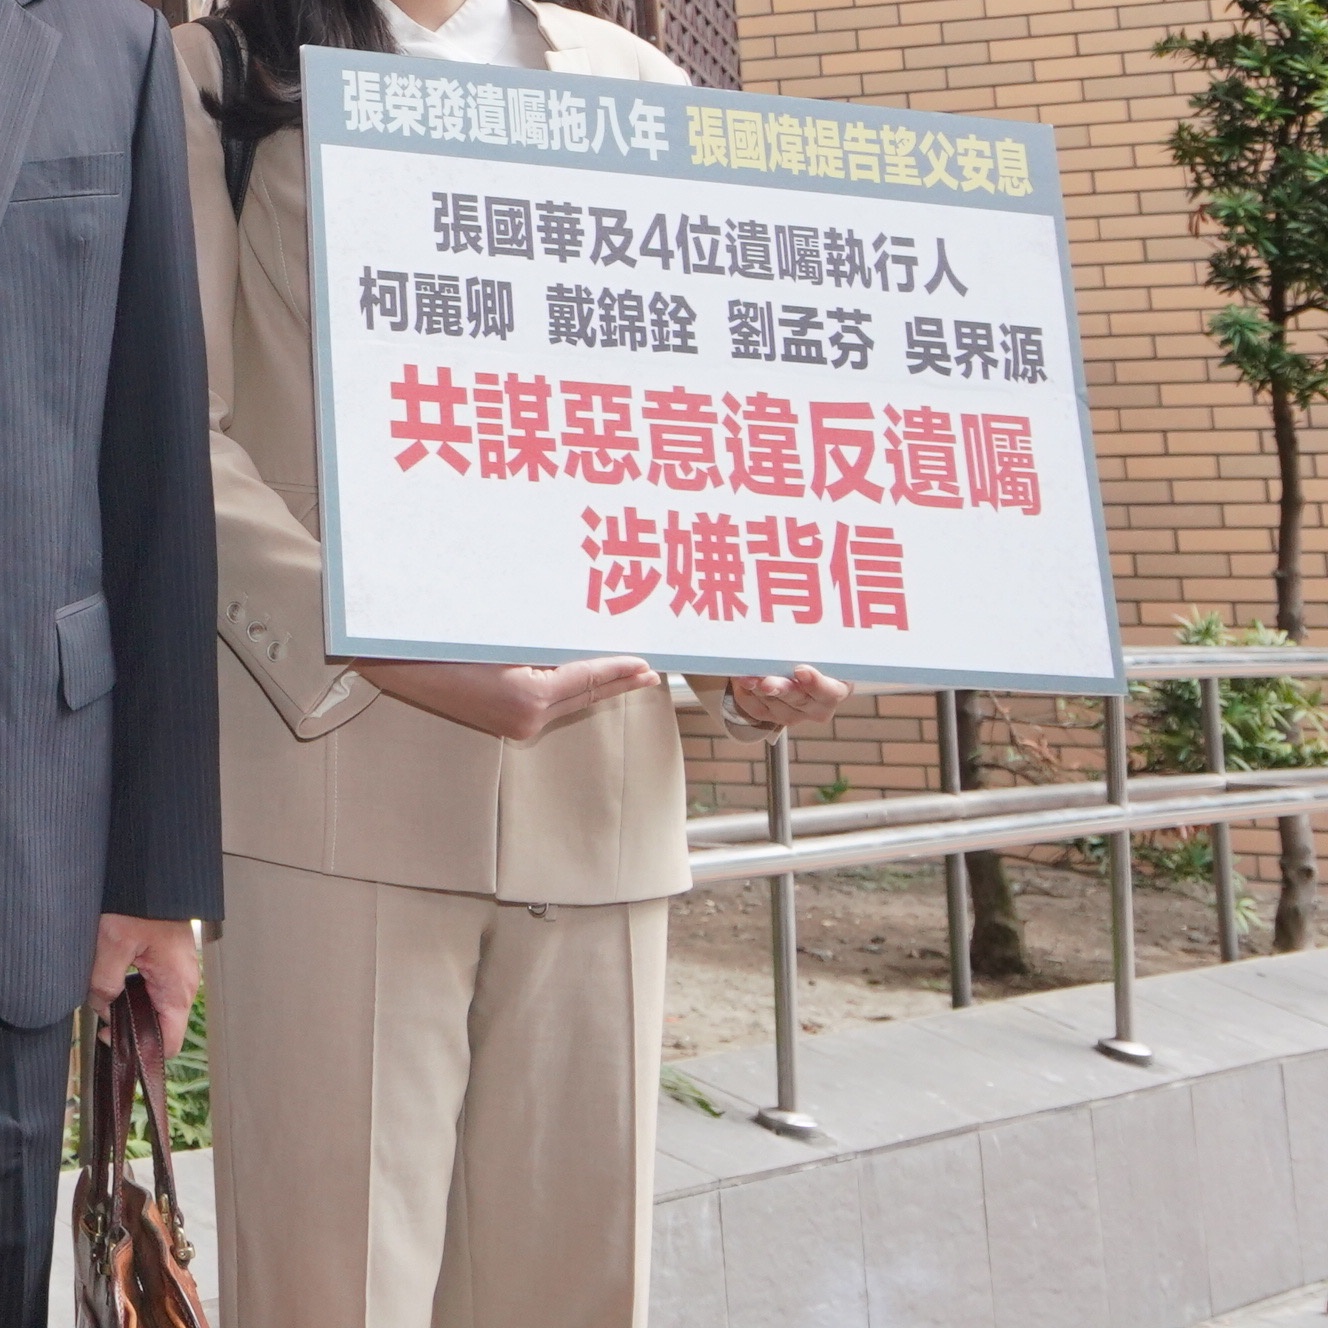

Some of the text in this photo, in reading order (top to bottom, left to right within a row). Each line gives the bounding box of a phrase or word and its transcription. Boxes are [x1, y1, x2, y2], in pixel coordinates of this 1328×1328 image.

[341, 69, 1034, 198] 張榮發遺囑拖八年 張國煒提告望父安息
[432, 191, 969, 297] 張國華及4位遺囑執行人
[359, 265, 1048, 385] 柯麗卿 戴錦銓 劉孟芬 吳界源
[389, 364, 1043, 517] 共謀惡意違反遺囑
[580, 505, 910, 633] 涉嫌背信
